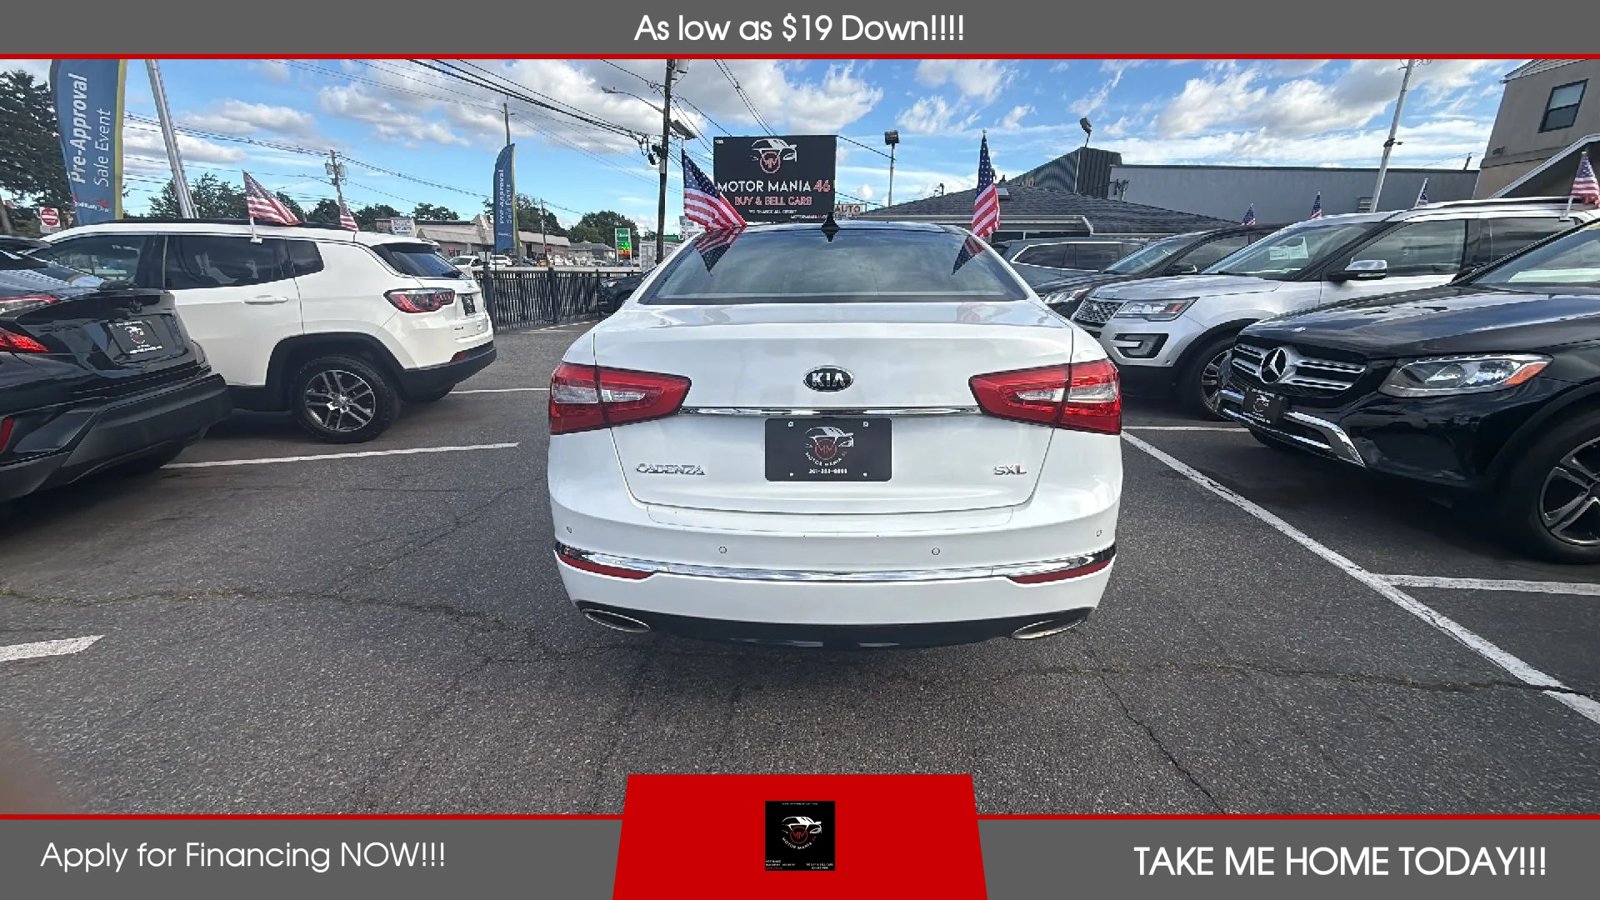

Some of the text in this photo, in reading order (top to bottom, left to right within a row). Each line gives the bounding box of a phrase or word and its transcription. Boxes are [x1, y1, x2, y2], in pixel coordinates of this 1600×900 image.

[68, 73, 92, 184] Pre-Approval
[95, 108, 111, 151] Event
[93, 156, 109, 187] Sale
[717, 179, 831, 193] MOTOR MANIA 46
[734, 196, 754, 206] BUY
[755, 196, 762, 206] &
[811, 372, 846, 387] KIA
[636, 463, 705, 476] CADENZA
[994, 464, 1027, 476] SXL
